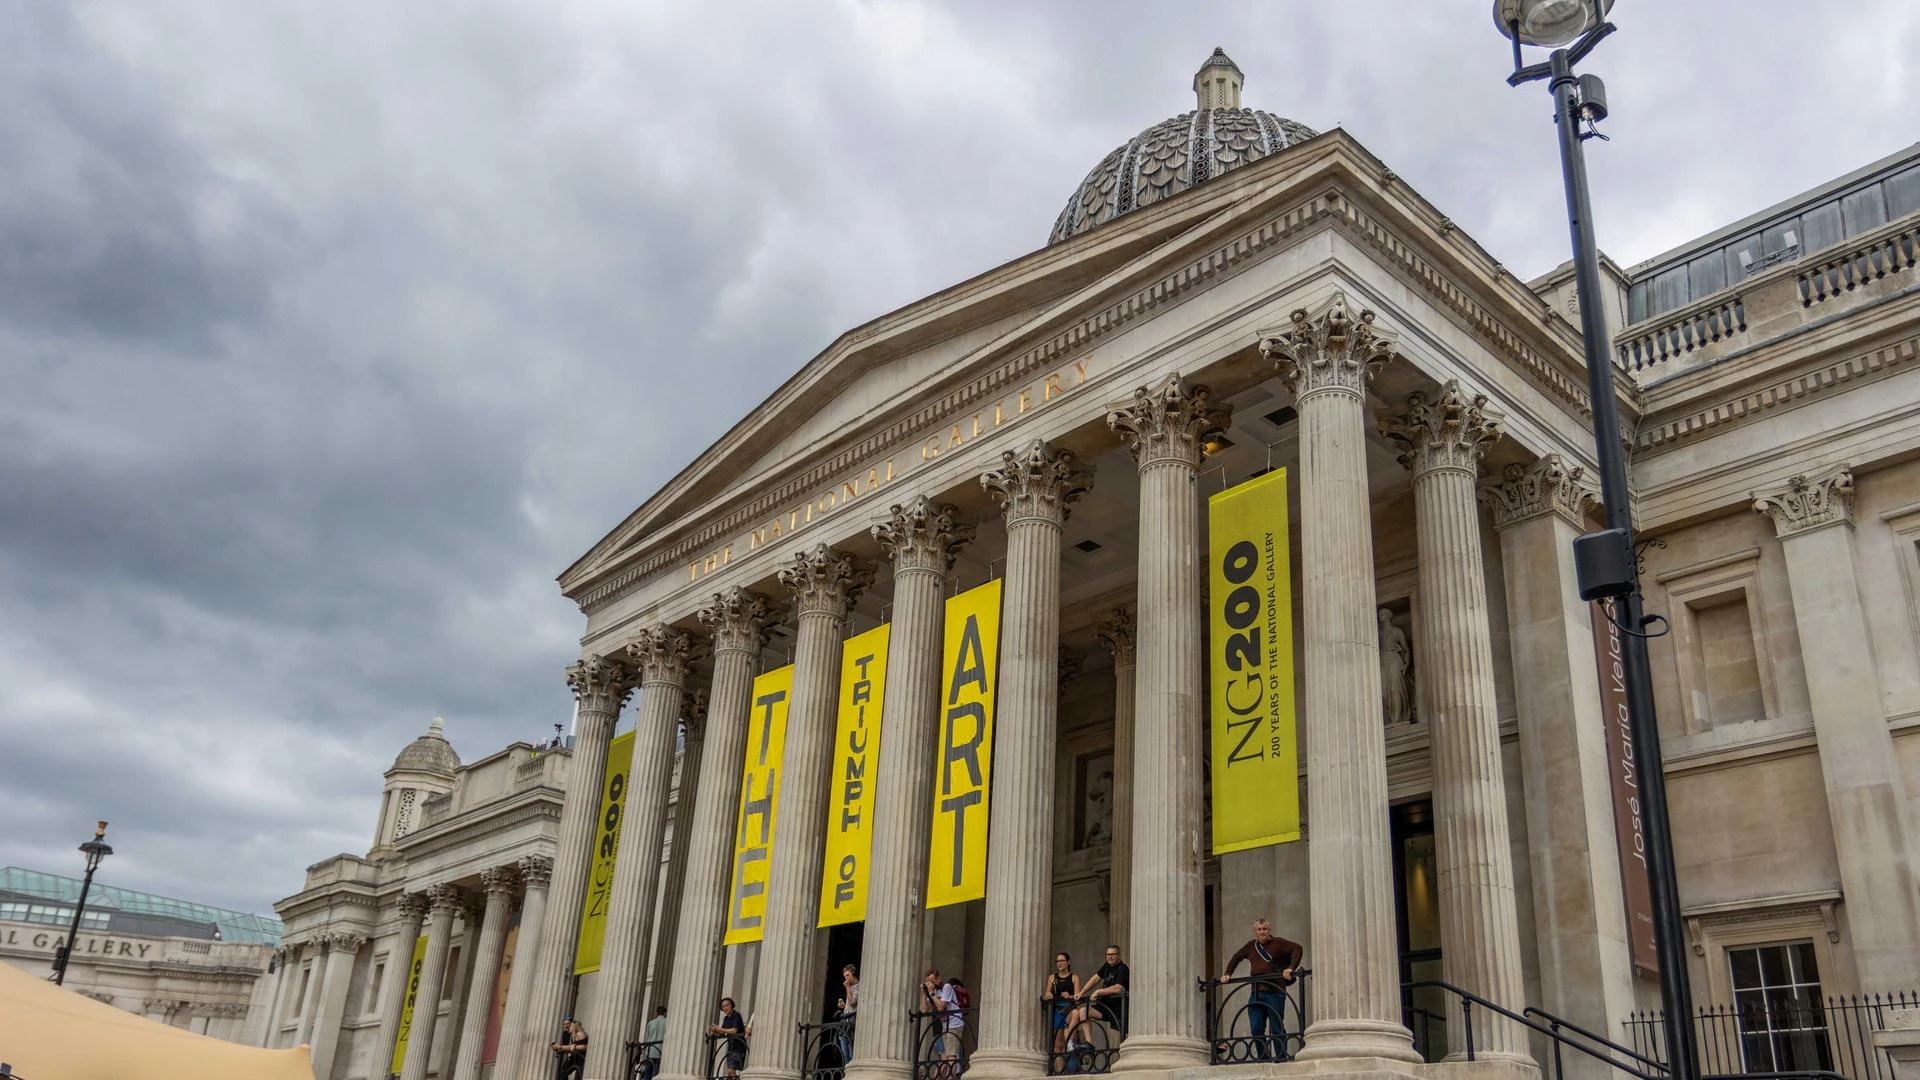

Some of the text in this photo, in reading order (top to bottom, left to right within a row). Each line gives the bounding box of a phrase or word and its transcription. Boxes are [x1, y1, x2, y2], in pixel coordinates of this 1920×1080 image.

[689, 354, 1095, 581] THE NATIONAL GALLERY
[940, 613, 988, 888] ART
[1223, 540, 1264, 769] NG200
[1264, 532, 1281, 759] 200 YEARS OF THE NATIONAL GALLERY
[1618, 703, 1638, 789] María
[590, 772, 624, 919] NG200
[731, 689, 787, 931] THE
[834, 653, 875, 909] TRIUMPH OF
[1627, 796, 1647, 870] José
[32, 932, 152, 958] GALLERY
